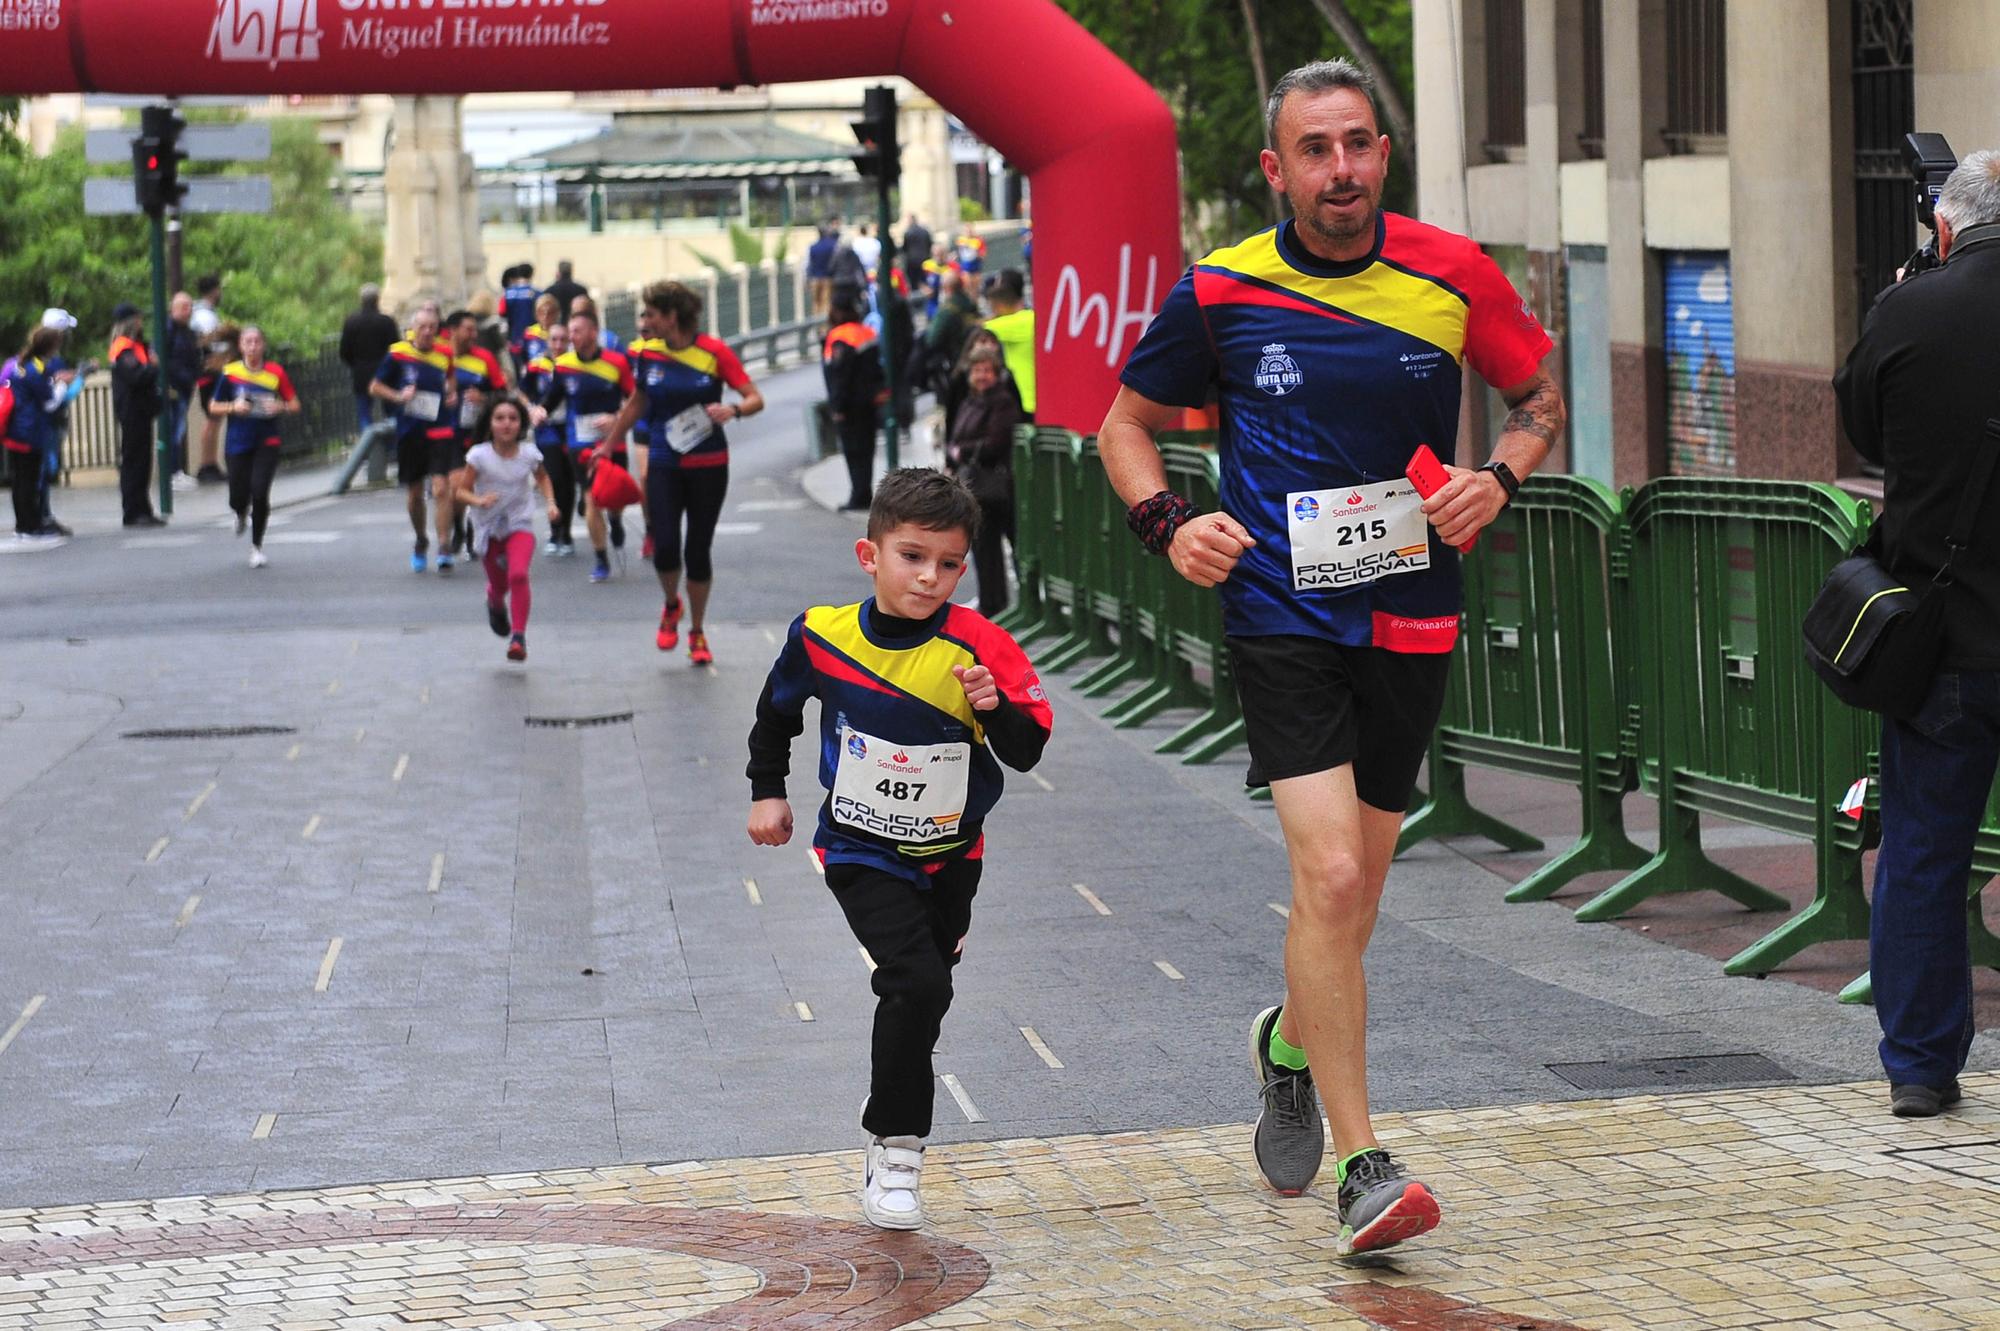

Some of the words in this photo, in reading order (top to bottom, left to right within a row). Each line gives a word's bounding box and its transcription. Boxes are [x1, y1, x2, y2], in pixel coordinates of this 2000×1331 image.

[751, 0, 889, 26] MOVIMIENTO
[341, 15, 444, 59] Miguel
[453, 13, 610, 48] Hernández
[1256, 374, 1280, 386] RUTA
[1282, 372, 1300, 383] 091
[1332, 503, 1378, 518] Santander
[1336, 519, 1387, 547] 215
[1297, 550, 1401, 576] POLICIA
[1298, 557, 1428, 587] NACIONAL
[877, 759, 923, 774] Santander
[943, 754, 963, 762] mupol
[875, 778, 927, 802] 487
[834, 808, 957, 838] NACIONAL
[835, 795, 936, 827] POLICIA
